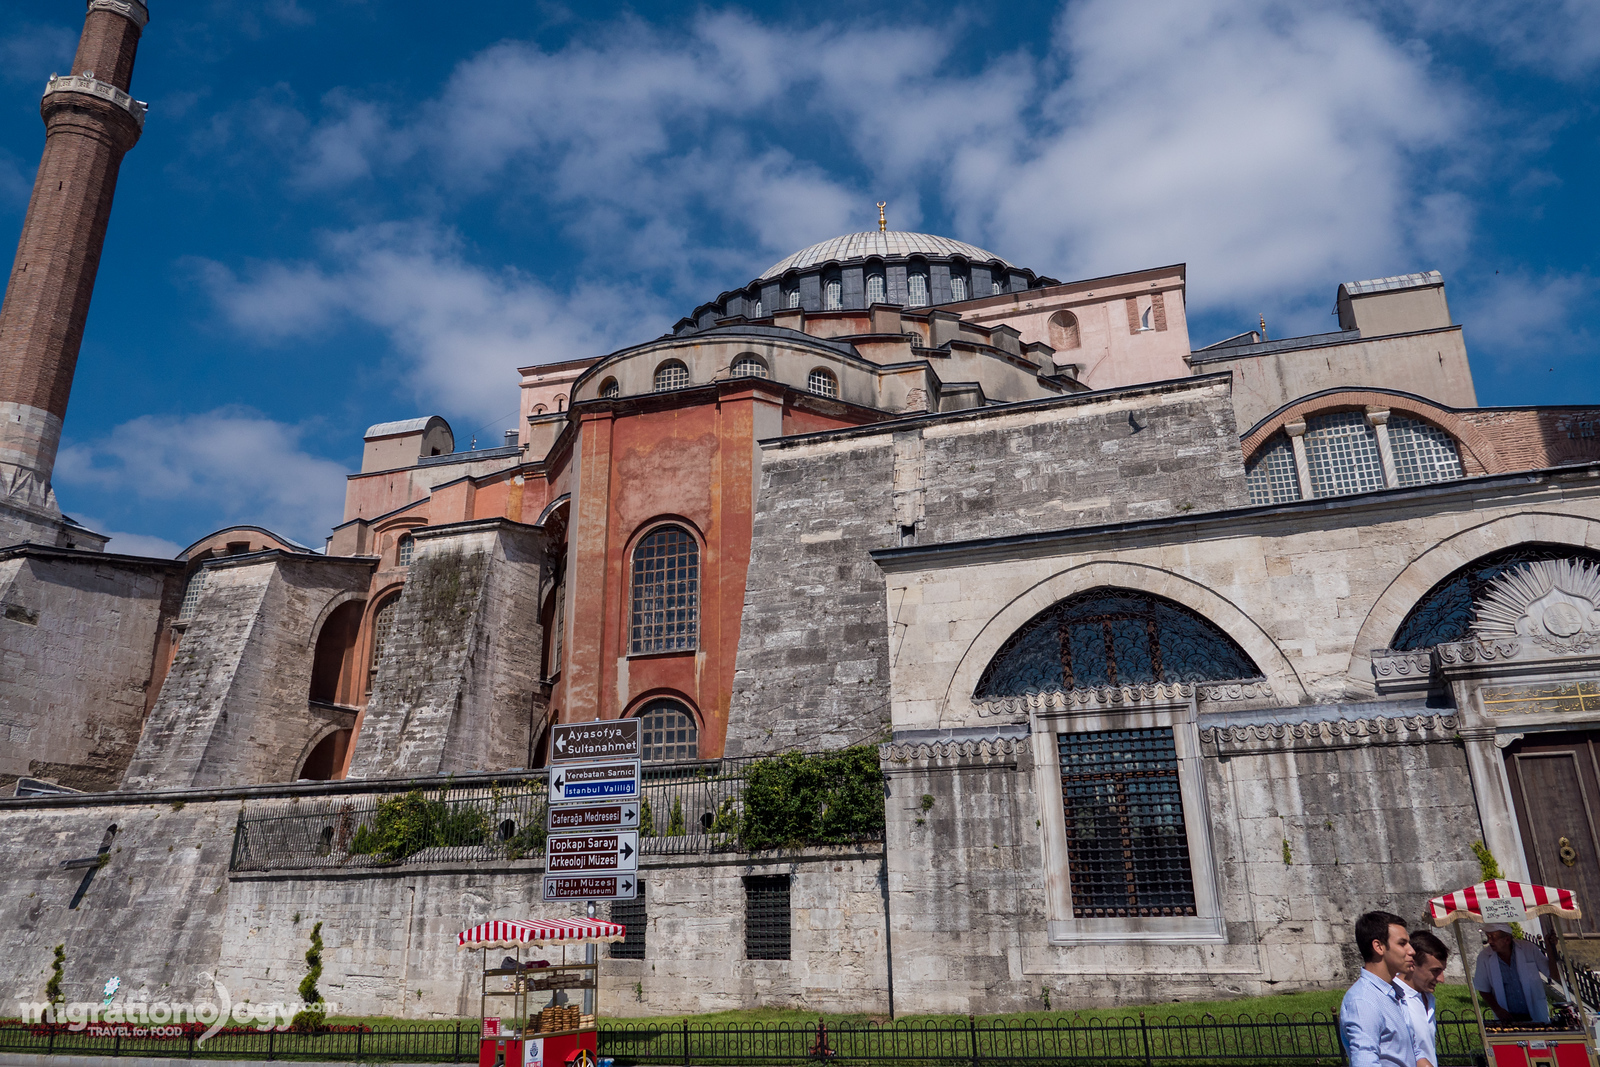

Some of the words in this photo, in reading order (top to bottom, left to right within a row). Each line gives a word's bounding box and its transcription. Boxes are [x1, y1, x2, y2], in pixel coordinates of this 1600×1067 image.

[568, 728, 622, 741] Ayasofya
[568, 740, 637, 754] Sultanahmet
[566, 771, 605, 780] Yerebatan
[565, 785, 600, 795] İstanbul
[604, 783, 634, 793] Valiliği
[552, 813, 583, 826] Caferağa
[584, 811, 620, 822] Medresesi
[551, 839, 586, 852] Topkapı
[588, 838, 617, 850] Sarayı
[550, 855, 586, 869] Arkeoloji
[588, 854, 617, 866] Müzesi
